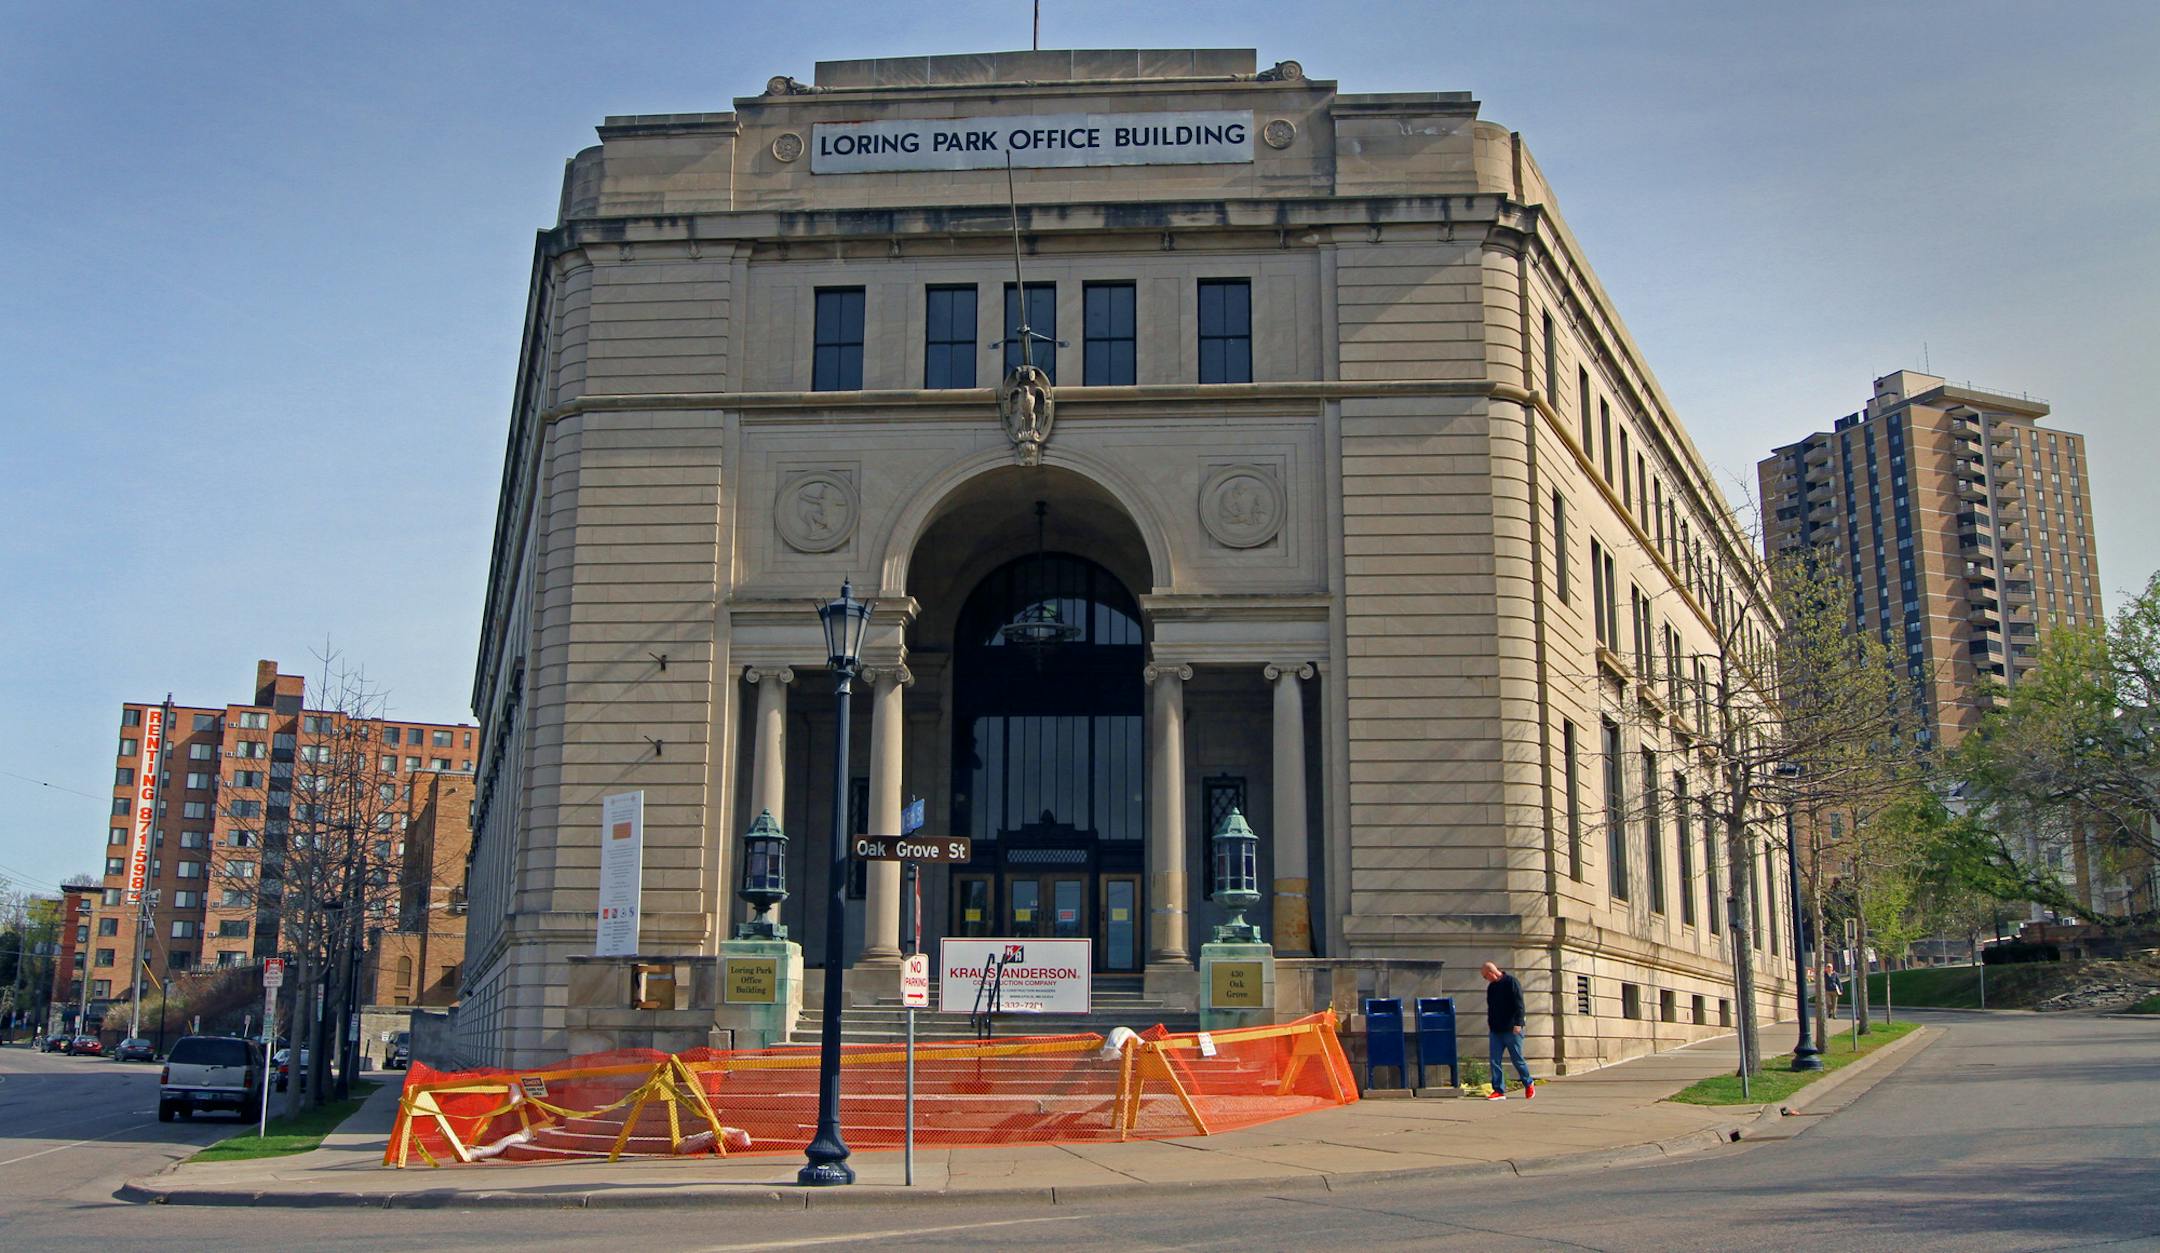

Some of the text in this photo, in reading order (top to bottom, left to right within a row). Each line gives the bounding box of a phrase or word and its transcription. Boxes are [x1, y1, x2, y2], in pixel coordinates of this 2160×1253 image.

[820, 123, 1246, 156] LORING PARK OFFICE BUILDING
[856, 839, 966, 859] Oak Grove St
[730, 966, 772, 975] Loring Park
[910, 960, 922, 974] NO
[1000, 967, 1078, 979] ANDERSON
[740, 976, 762, 984] Office
[904, 977, 928, 988] PARKING
[1229, 980, 1245, 988] Oak
[736, 986, 767, 995] Building
[1226, 990, 1248, 999] Grove
